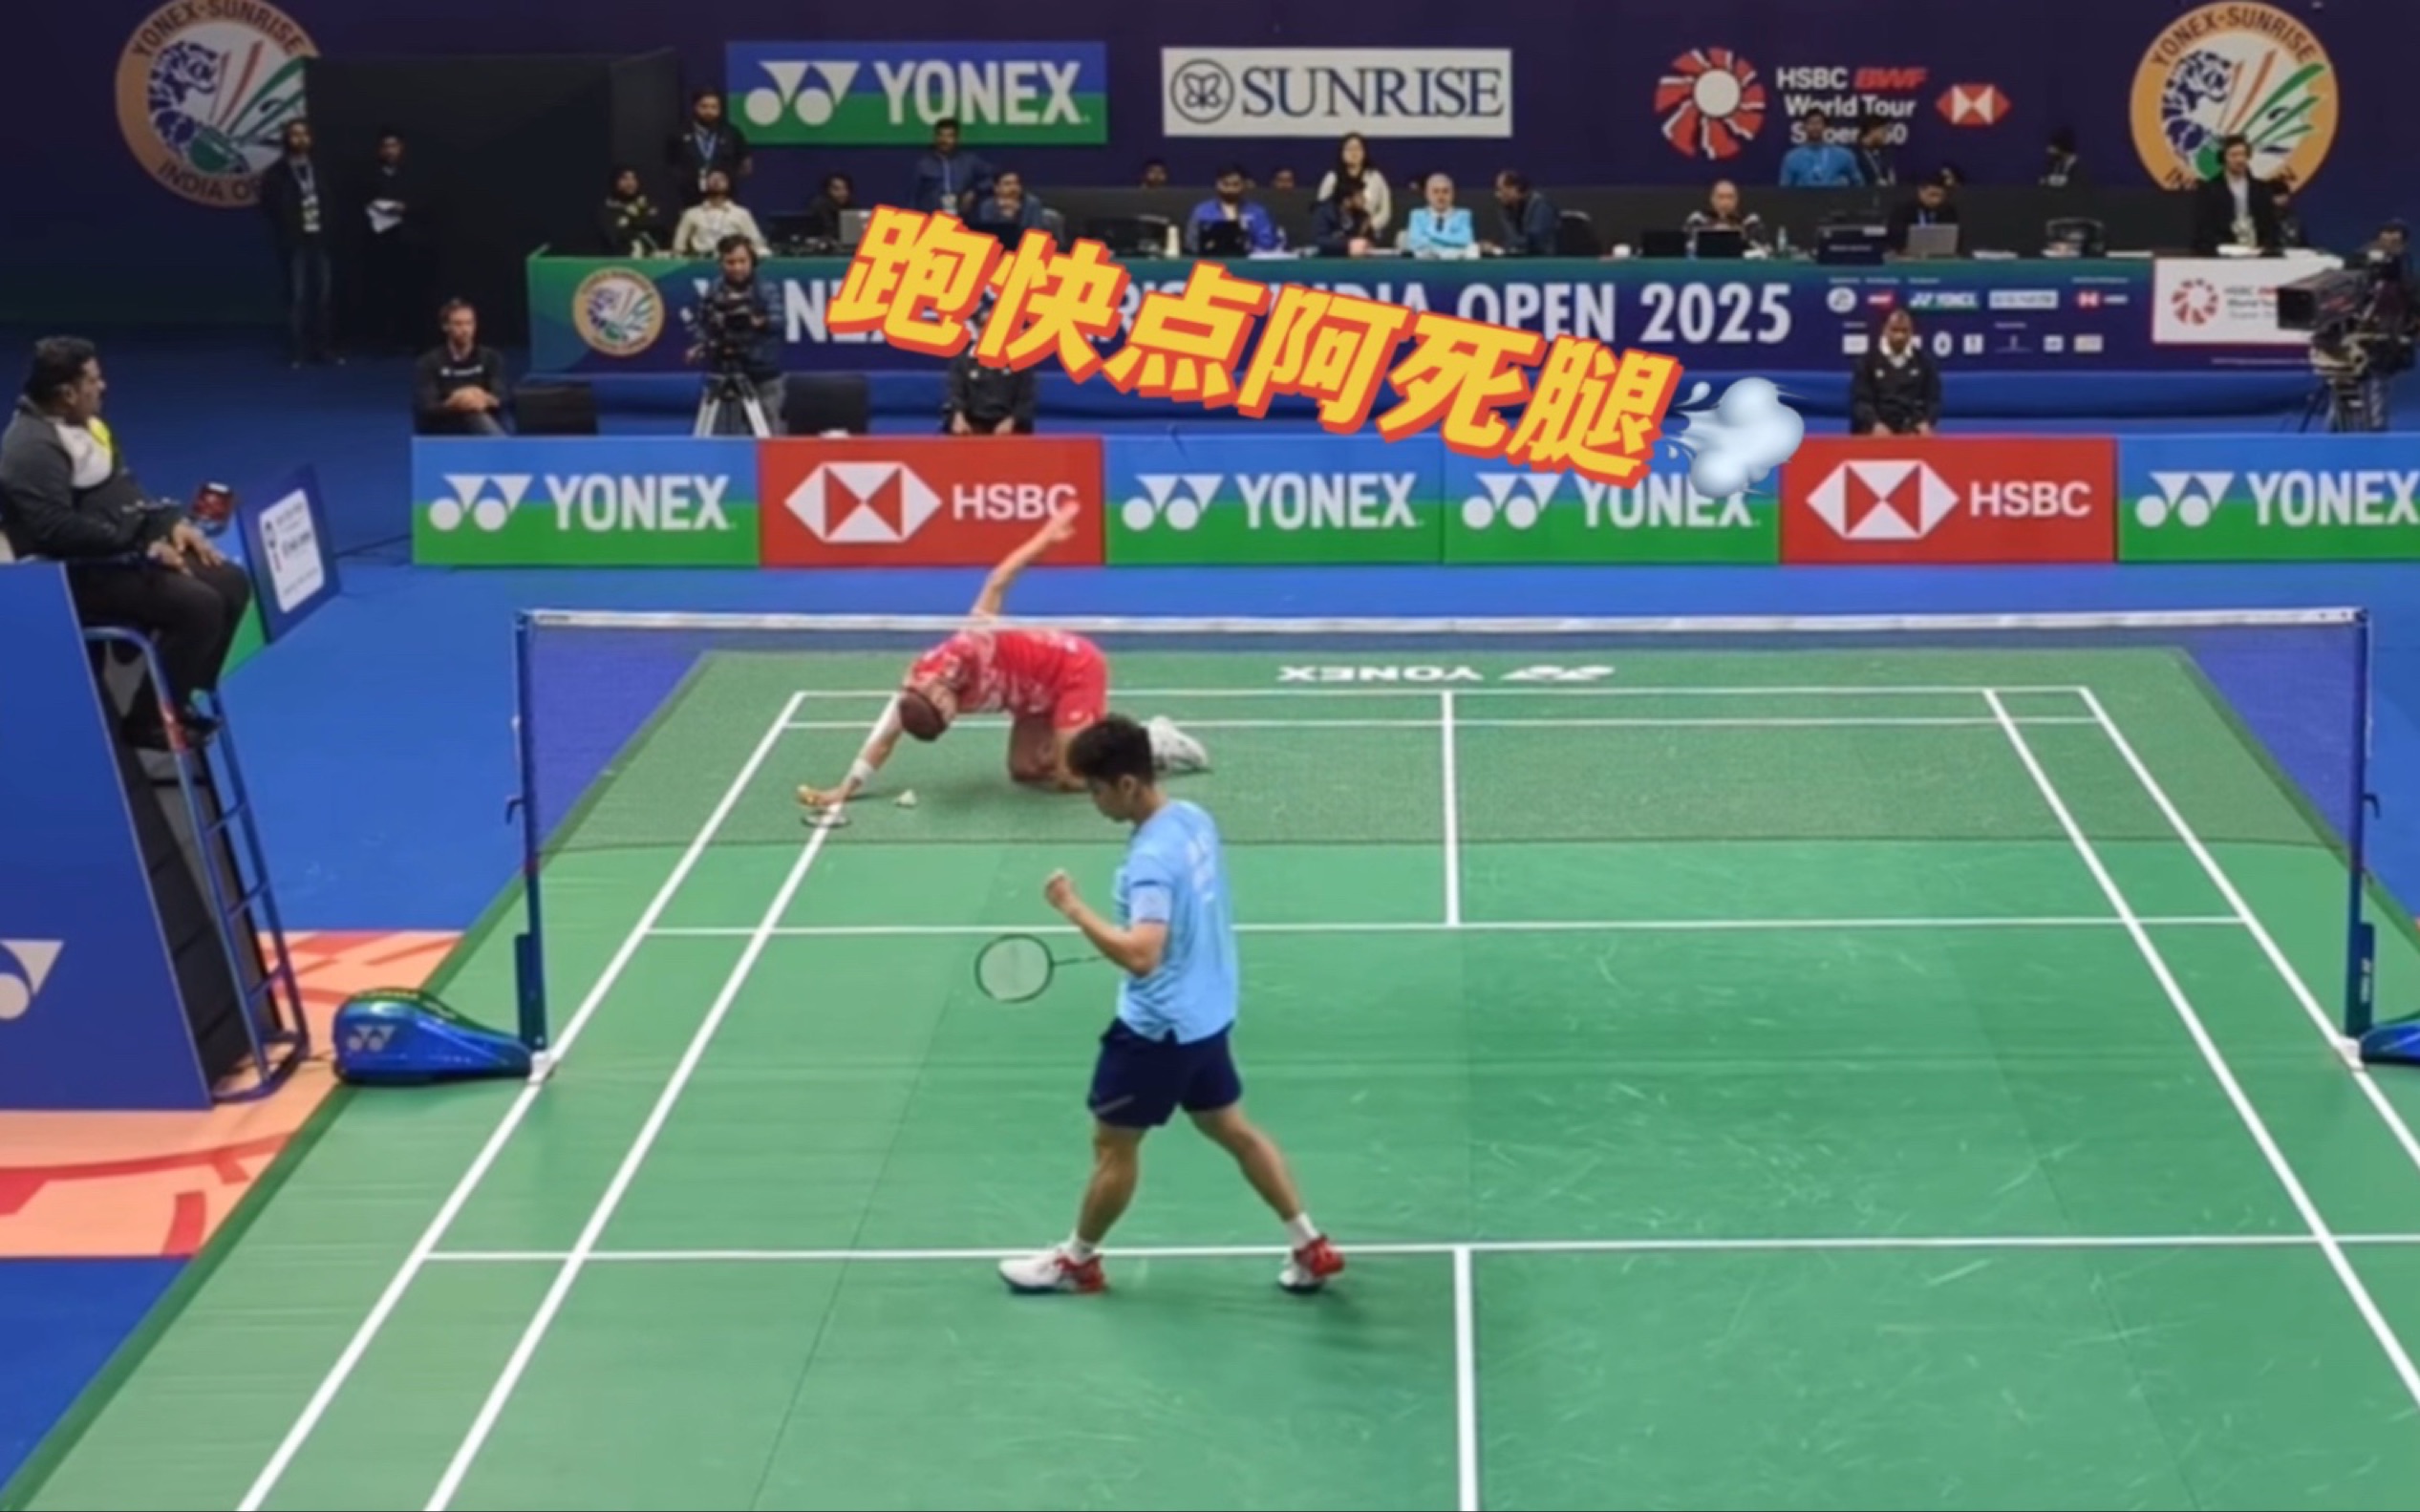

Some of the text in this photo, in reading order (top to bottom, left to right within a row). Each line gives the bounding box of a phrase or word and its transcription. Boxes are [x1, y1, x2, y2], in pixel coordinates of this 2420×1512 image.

[873, 59, 1082, 125] YONEX
[1241, 66, 1505, 118] SUNRISE
[1776, 67, 1927, 90] HSBC BWF
[1784, 94, 1916, 117] World Tour
[1457, 283, 1616, 342] OPEN
[1638, 282, 1791, 344] 2025
[546, 474, 728, 531] YONEX
[952, 483, 1078, 522] HSBC
[1235, 473, 1417, 529] YONEX
[1969, 480, 2092, 517] HSBC
[2246, 470, 2420, 527] YONEX
